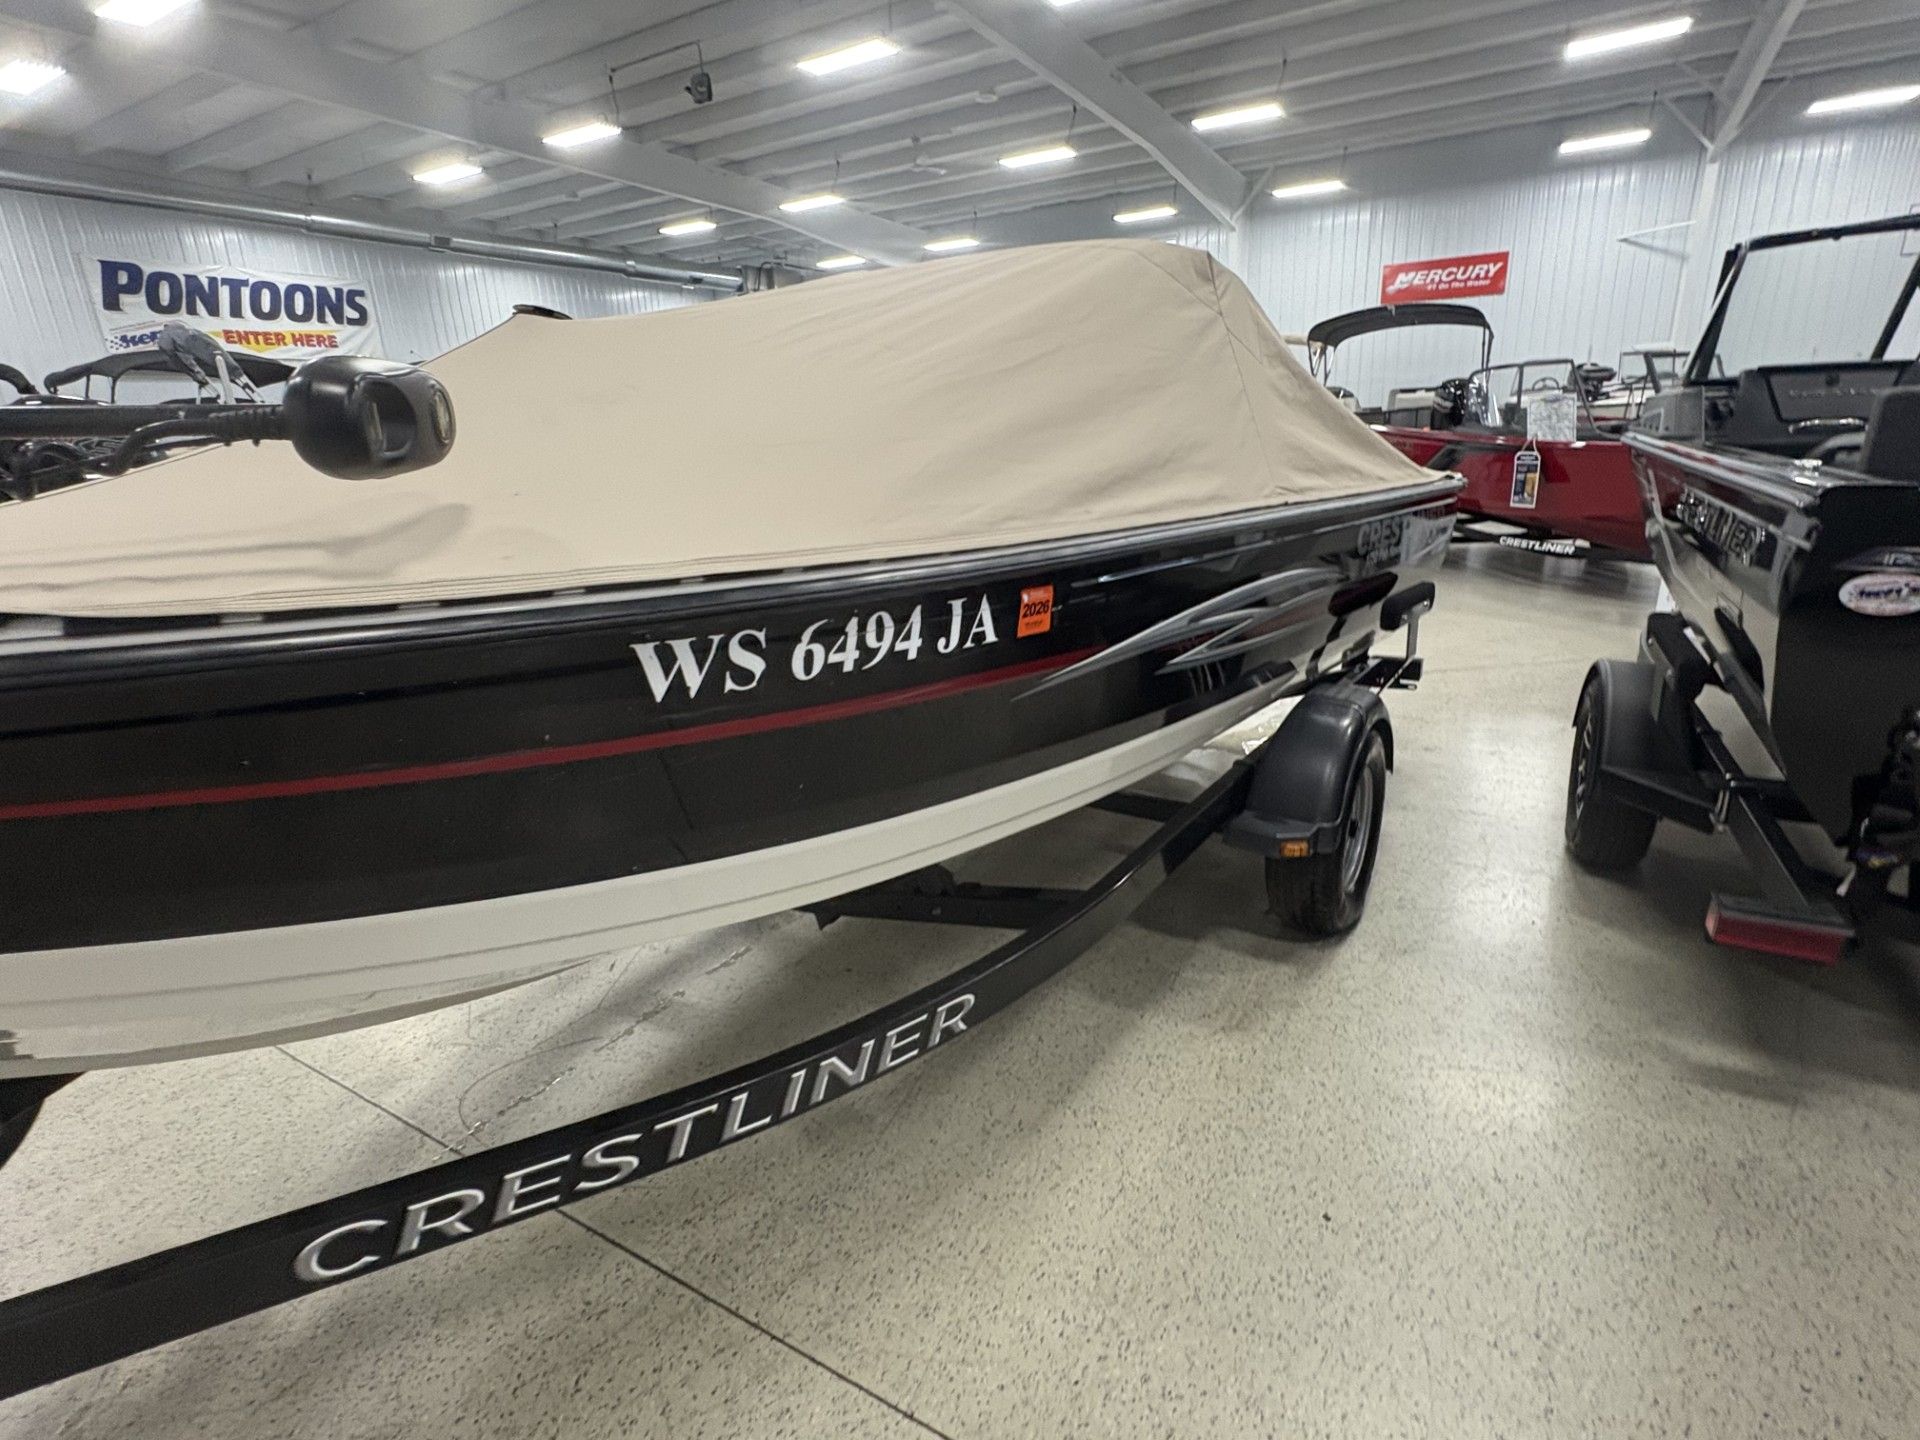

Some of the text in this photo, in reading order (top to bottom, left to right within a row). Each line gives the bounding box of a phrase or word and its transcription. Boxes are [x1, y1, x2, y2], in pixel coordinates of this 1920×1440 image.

[97, 259, 368, 326] PONTOONS
[1387, 262, 1503, 293] MERCURY
[222, 329, 339, 349] ENTER HERE
[1500, 536, 1575, 556] CRESTLINER
[1022, 600, 1050, 619] 2026
[629, 593, 999, 703] WS 6494 JA
[293, 992, 976, 1284] CRESTLINER
